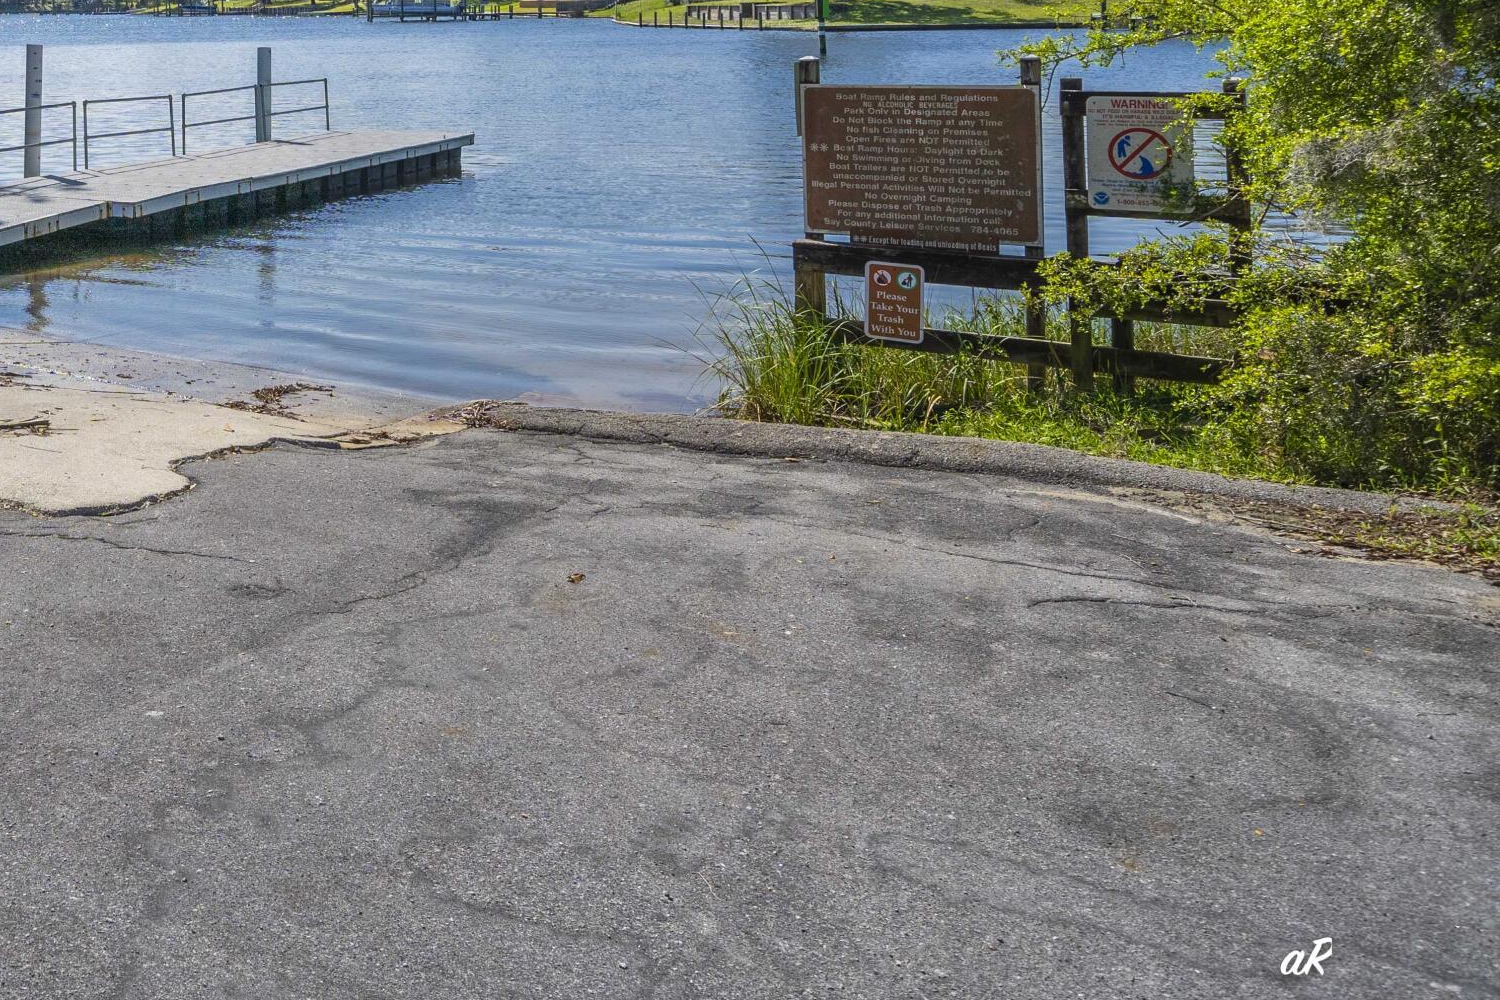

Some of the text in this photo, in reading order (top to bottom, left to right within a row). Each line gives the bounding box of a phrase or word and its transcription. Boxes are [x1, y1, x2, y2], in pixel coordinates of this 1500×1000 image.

[941, 94, 998, 102] Regulations
[1111, 100, 1168, 109] WARNING!
[904, 109, 957, 117] Designated
[915, 118, 942, 126] Ramp
[883, 127, 924, 136] Cleaning
[943, 128, 988, 136] Premises
[846, 135, 870, 144] Open
[943, 138, 990, 146] Permitted
[858, 145, 883, 153] Ramp
[925, 147, 964, 156] Daylight
[980, 148, 1003, 156] Dark
[852, 154, 898, 163] Swimming
[976, 158, 1000, 166] Dock
[933, 166, 980, 175] Permitted
[833, 173, 905, 182] unaccompanied
[958, 177, 1006, 187] Overnight
[812, 180, 837, 189] Illegal
[841, 181, 879, 189] Personal
[928, 185, 944, 193] Will
[949, 186, 965, 194] Not
[984, 187, 1031, 197] Permitted
[881, 193, 926, 202] Overnight
[930, 195, 972, 205] Camping
[829, 200, 858, 208] Please
[862, 201, 899, 209] Dispose
[946, 205, 1012, 216] Appropriately
[838, 209, 852, 217] For
[875, 210, 920, 220] additional
[824, 218, 1019, 236] Bay County Leisure Services 784-4065
[869, 236, 889, 244] Except
[891, 237, 899, 245] for
[925, 239, 936, 247] and
[938, 240, 969, 251] unloading
[877, 291, 907, 301] Please
[870, 302, 919, 314] Take Your
[877, 314, 903, 324] Trash
[871, 324, 915, 337] With You
